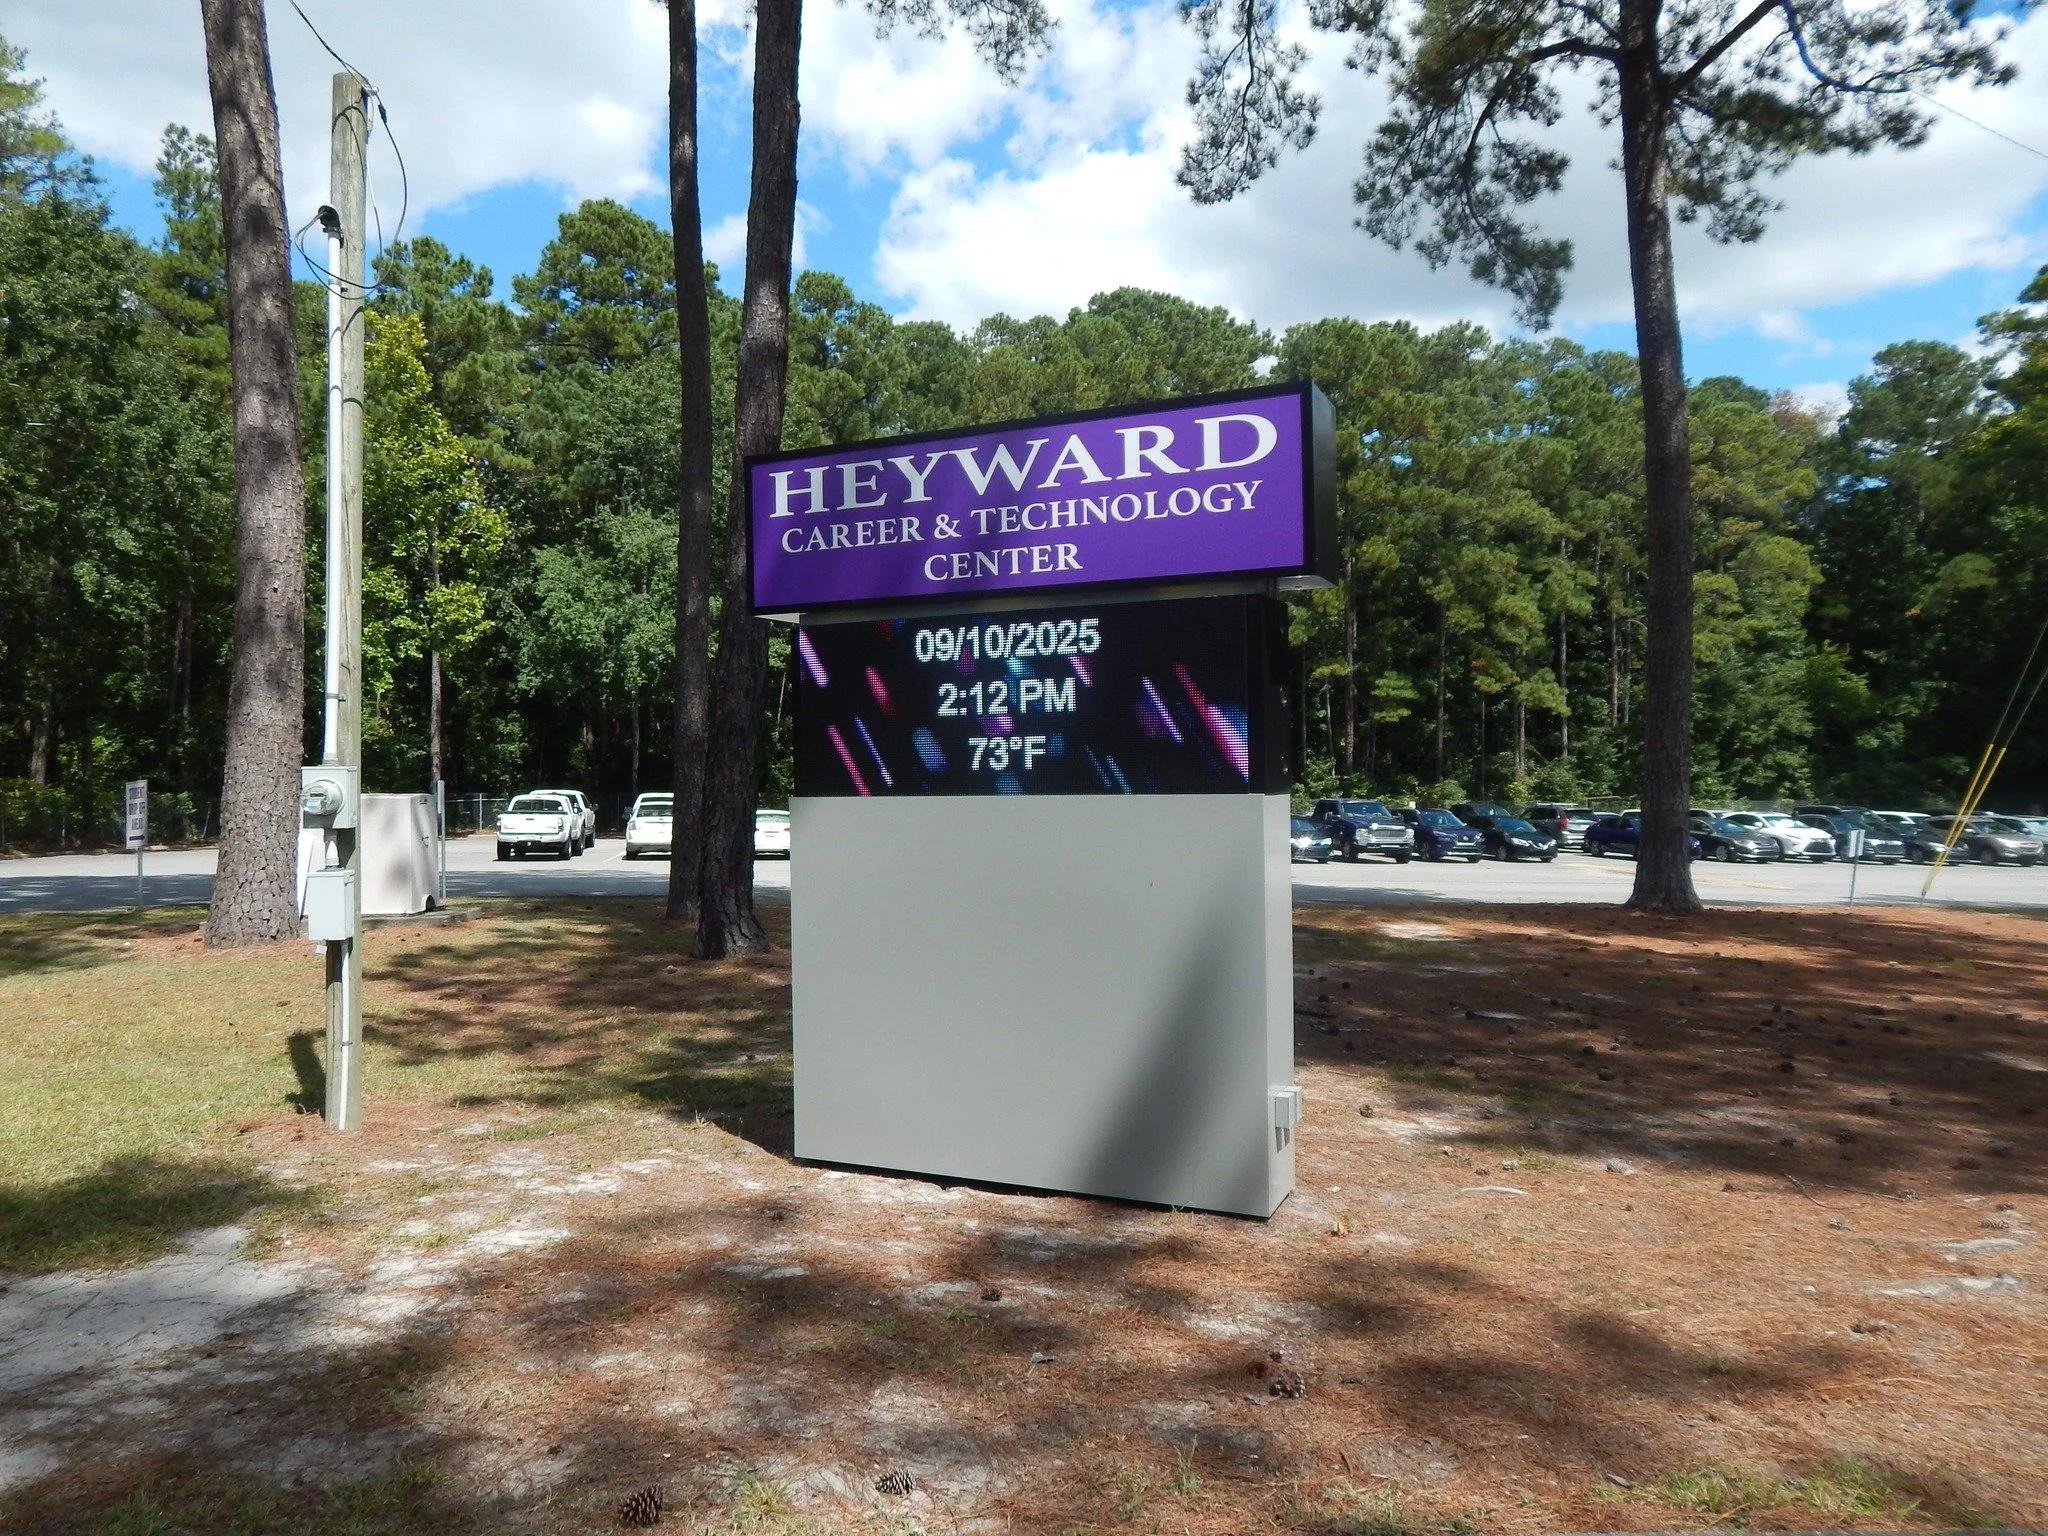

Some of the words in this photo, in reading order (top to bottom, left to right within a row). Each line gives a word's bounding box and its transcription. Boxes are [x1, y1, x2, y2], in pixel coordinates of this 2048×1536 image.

[769, 414, 1278, 518] HEYWARD
[782, 515, 923, 553] CAREER
[934, 513, 960, 539] &
[971, 480, 1262, 535] TECHNOLOGY
[924, 543, 1083, 581] CENTER
[915, 617, 1100, 662] 09/10/2025
[937, 683, 1008, 717] 2:12
[1019, 677, 1076, 713] PM
[969, 735, 1046, 770] 73°F
